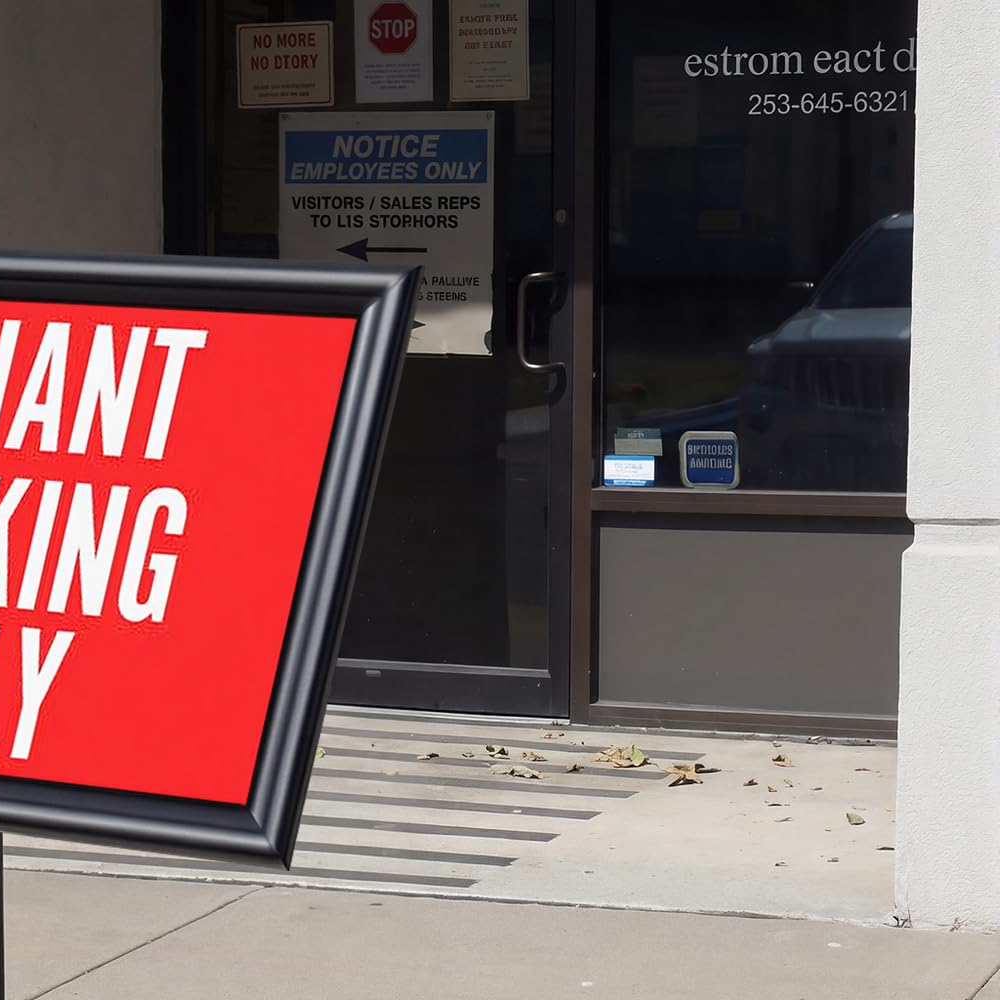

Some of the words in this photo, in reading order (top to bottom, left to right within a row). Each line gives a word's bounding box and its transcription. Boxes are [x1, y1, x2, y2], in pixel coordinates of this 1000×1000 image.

[370, 18, 415, 40] STOP
[253, 34, 272, 49] NO
[277, 32, 316, 48] MORE
[250, 55, 269, 71] NO
[683, 45, 804, 77] estrom
[813, 40, 886, 74] eact
[748, 90, 908, 115] 253-645-6321
[332, 134, 441, 159] NOTICE
[290, 161, 419, 181] EMPLOYEES
[424, 161, 482, 180] ONLY
[291, 196, 365, 210] VISITORS
[380, 195, 432, 210] SALES
[438, 195, 481, 210] REPS
[310, 214, 332, 228] TO
